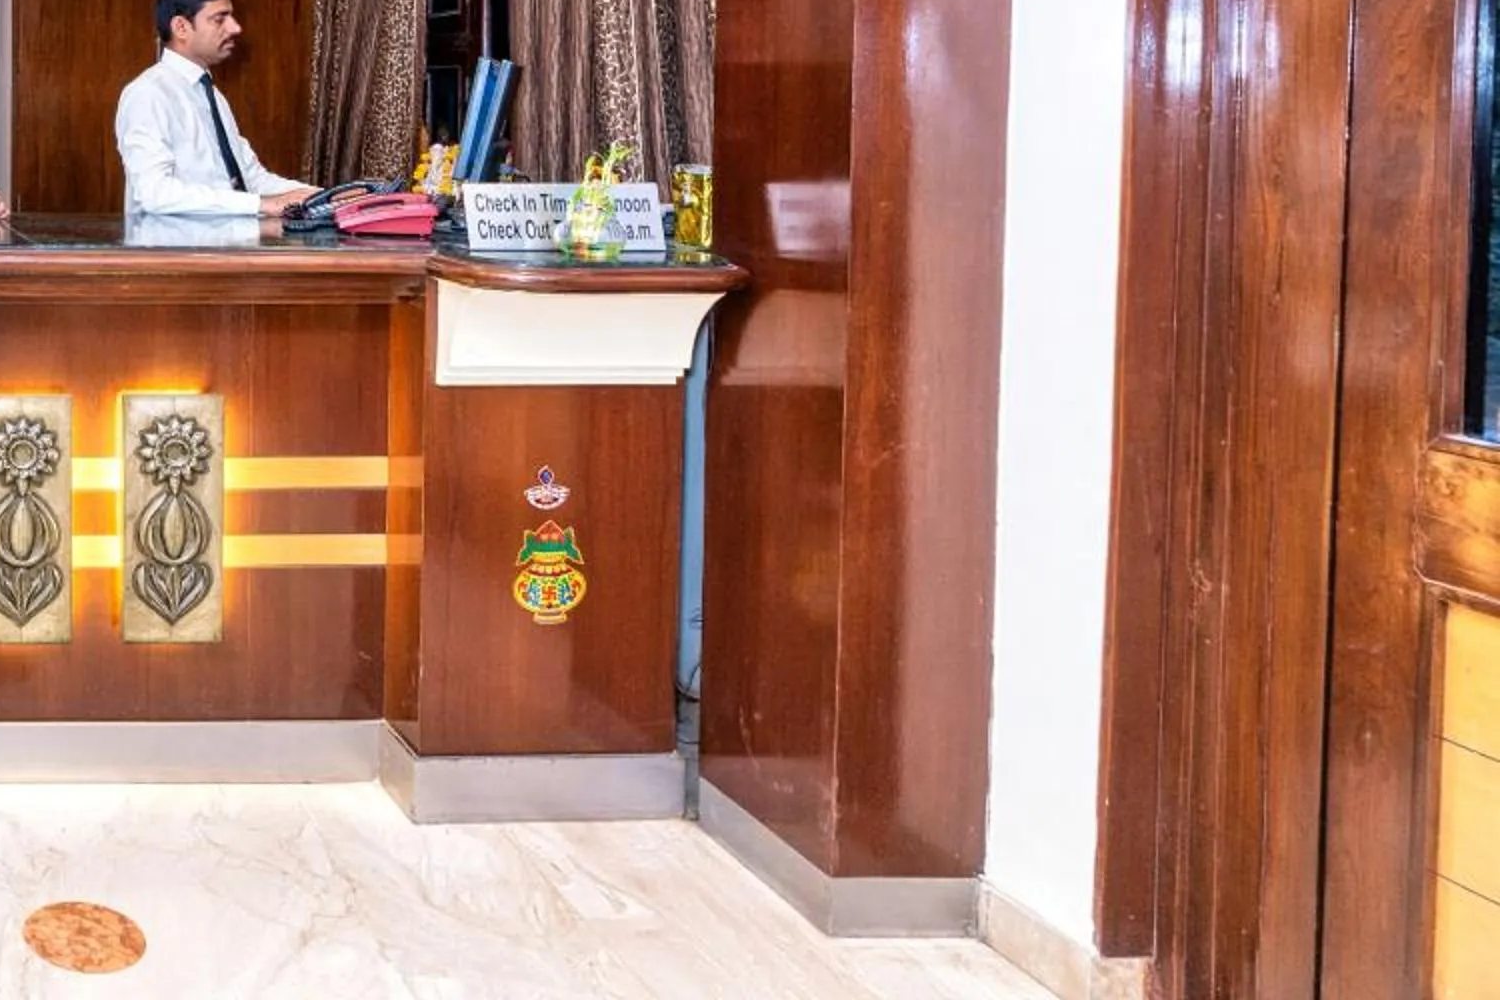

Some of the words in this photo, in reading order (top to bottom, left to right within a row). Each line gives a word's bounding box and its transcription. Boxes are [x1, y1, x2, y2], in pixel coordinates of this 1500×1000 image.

[475, 193, 517, 212] Check
[523, 194, 537, 212] In
[615, 197, 650, 212] noon
[477, 220, 522, 240] Check
[525, 220, 551, 239] Out
